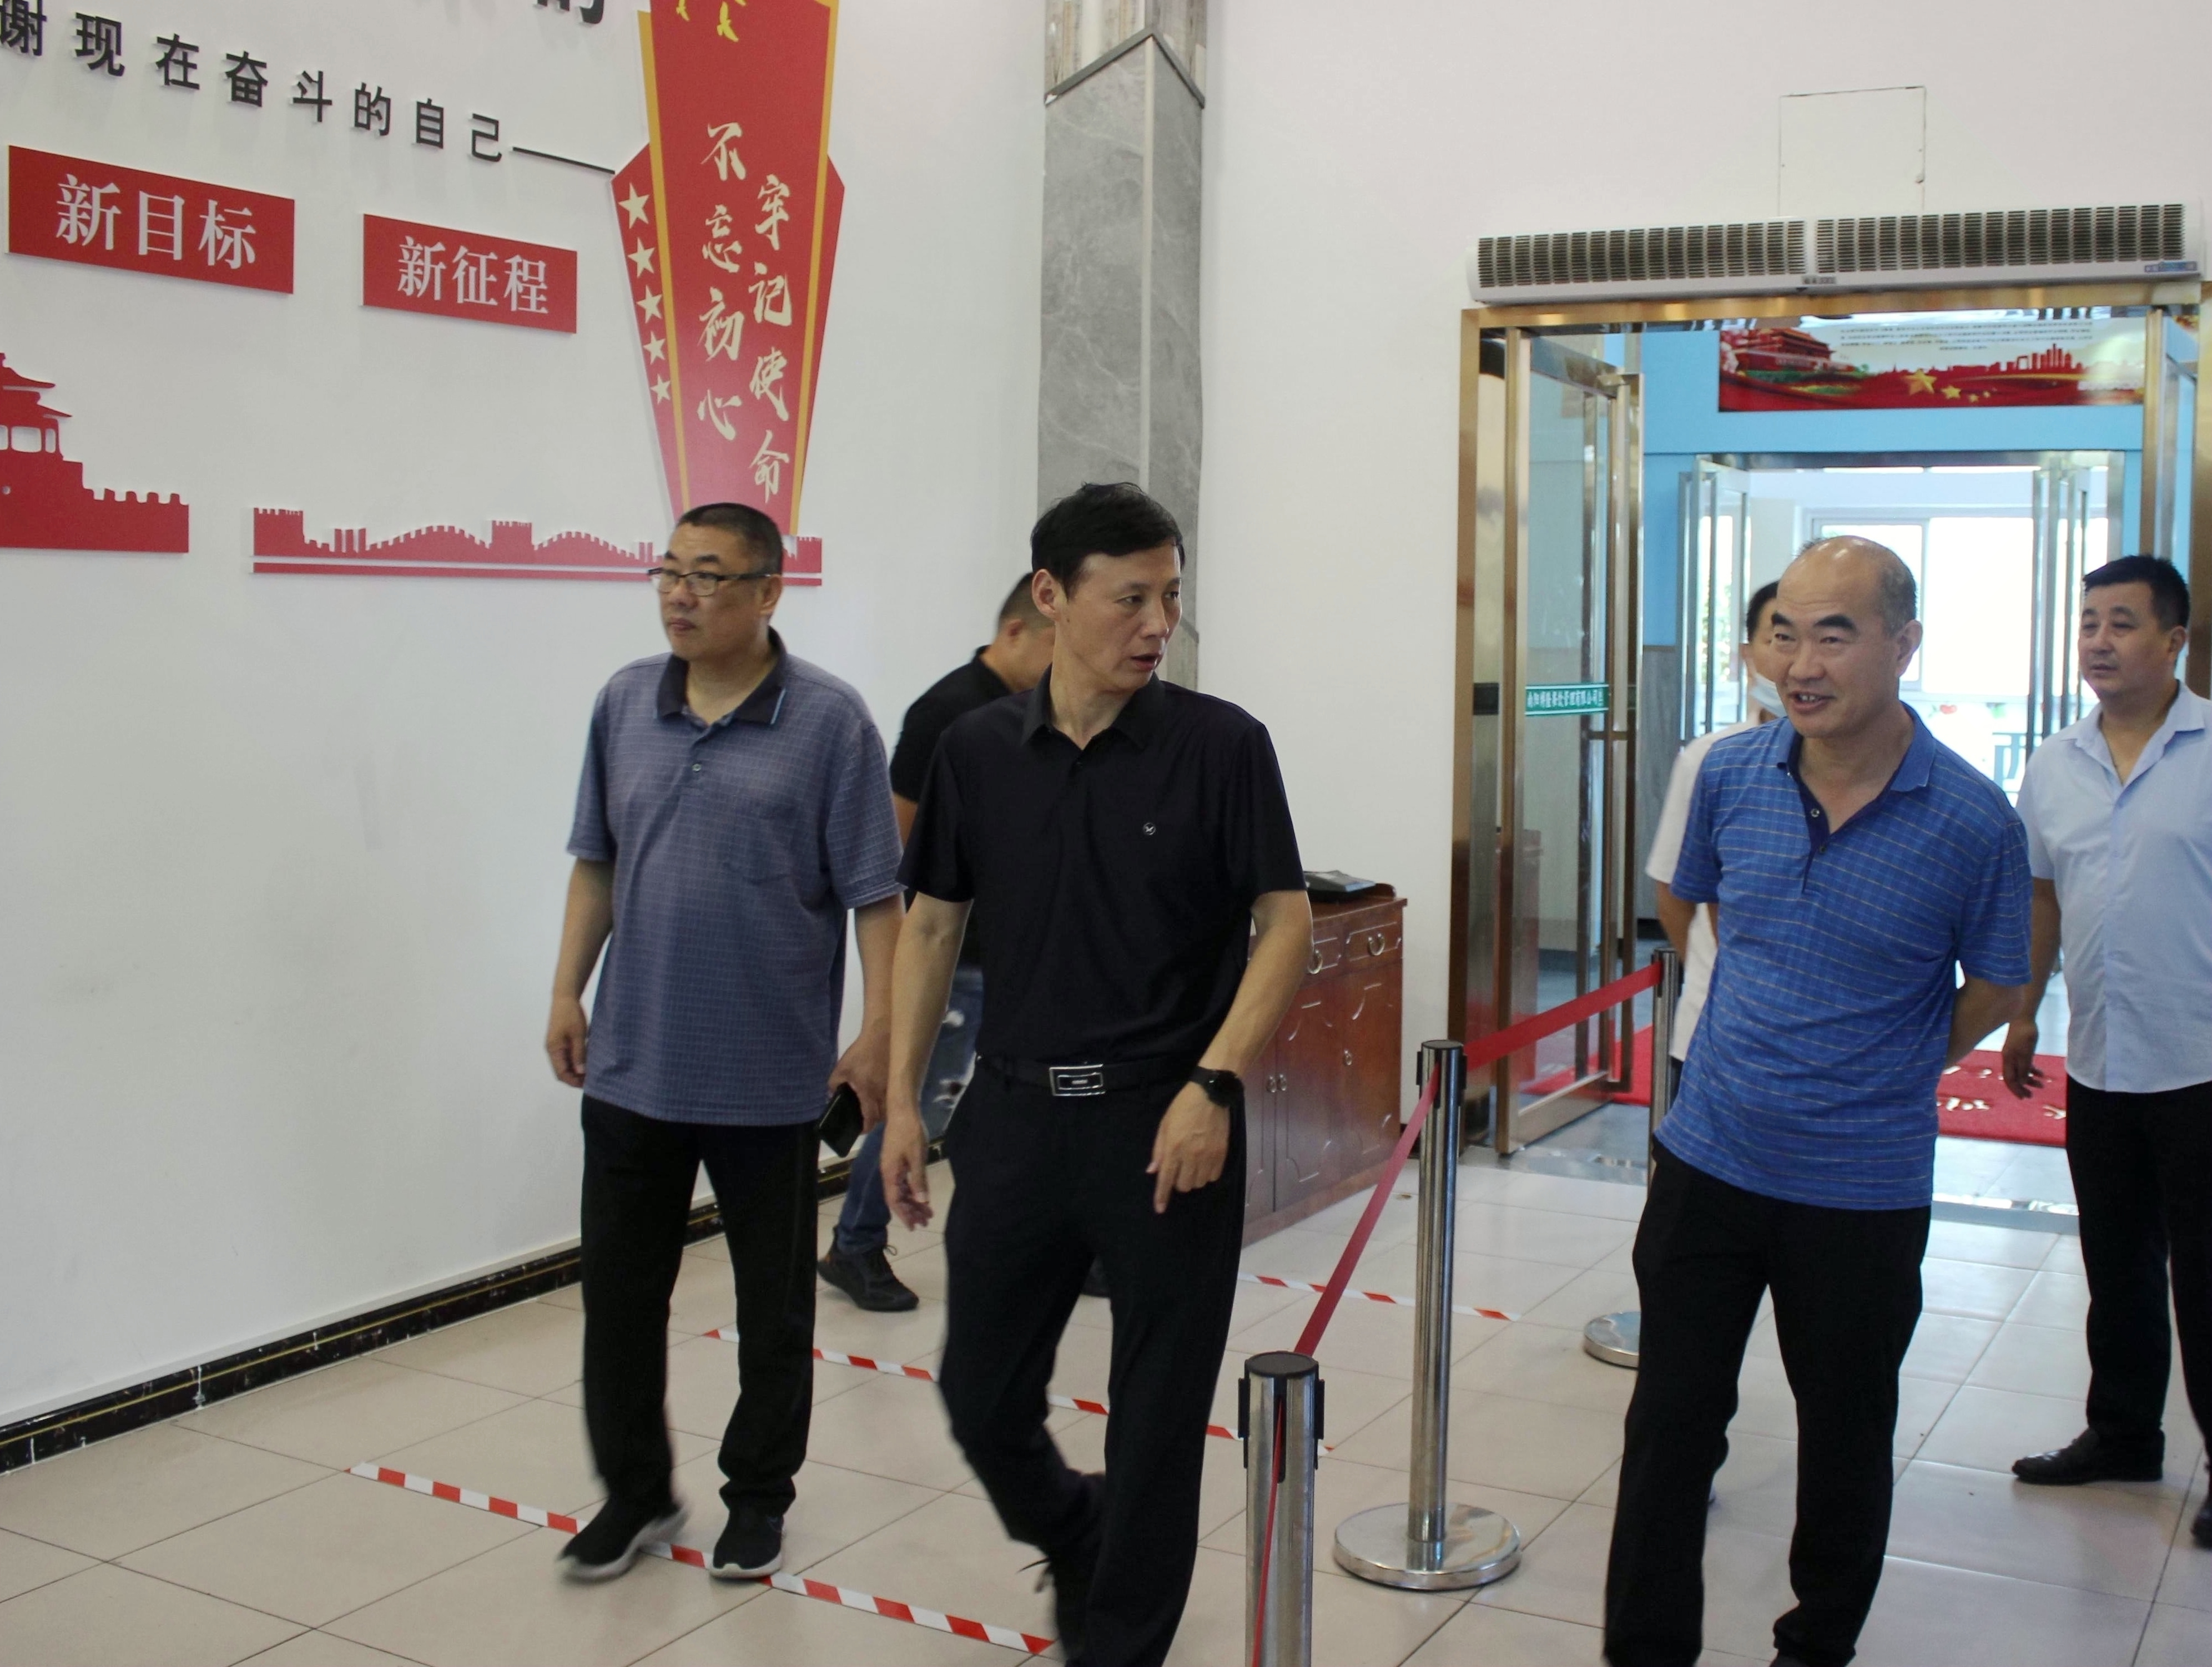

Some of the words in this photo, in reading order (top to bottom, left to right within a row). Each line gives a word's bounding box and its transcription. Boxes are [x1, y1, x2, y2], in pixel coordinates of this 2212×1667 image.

[56, 174, 256, 270] 新目标
[397, 236, 550, 314] 新征程
[697, 123, 746, 442] 不忘初心
[749, 175, 793, 503] 牢记使命
